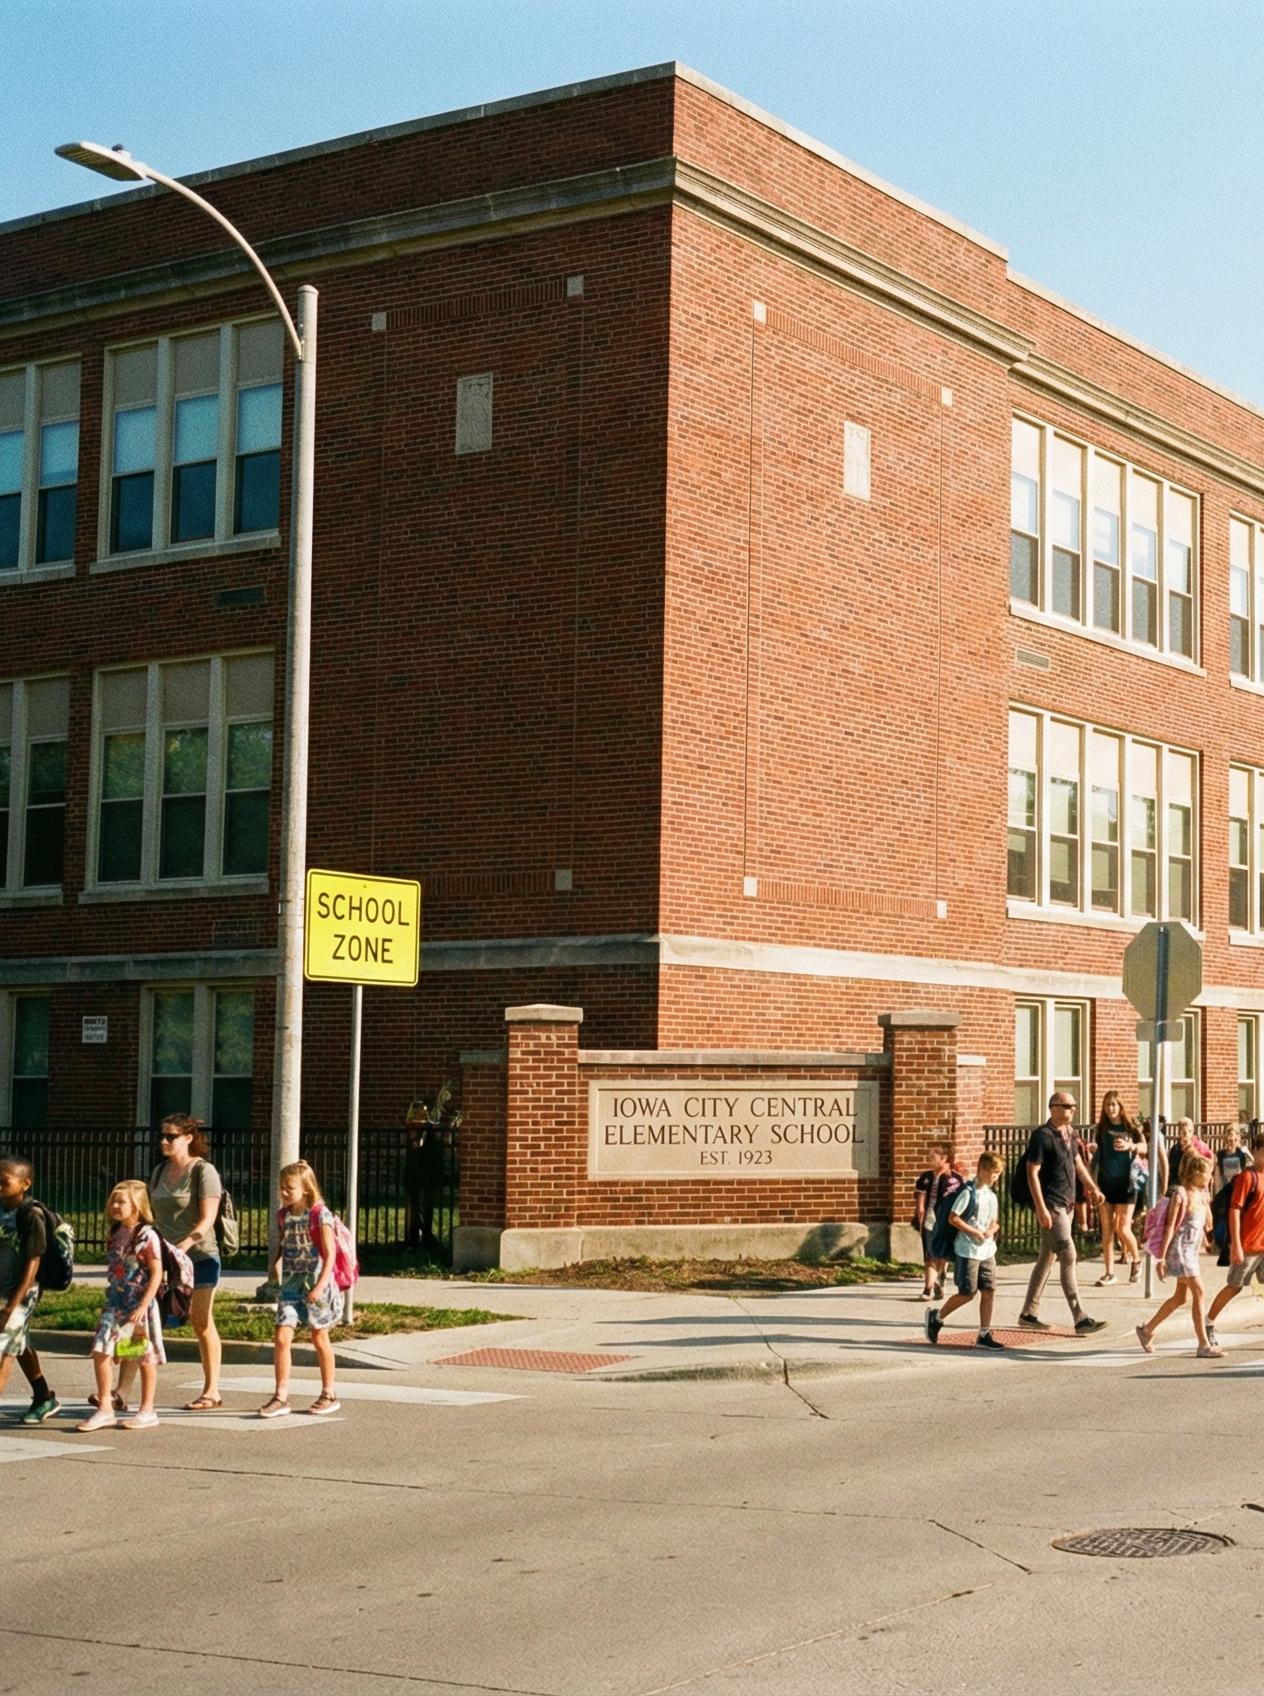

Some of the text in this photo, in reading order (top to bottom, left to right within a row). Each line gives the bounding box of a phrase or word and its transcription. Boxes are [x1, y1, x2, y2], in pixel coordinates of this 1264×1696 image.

[317, 892, 410, 926] SCHOOL
[332, 934, 393, 964] ZONE
[613, 1096, 858, 1118] IOWA CITY CENTRAL
[604, 1123, 864, 1146] ELEMENTARY SCHOOL
[700, 1150, 773, 1165] EST. 1923
